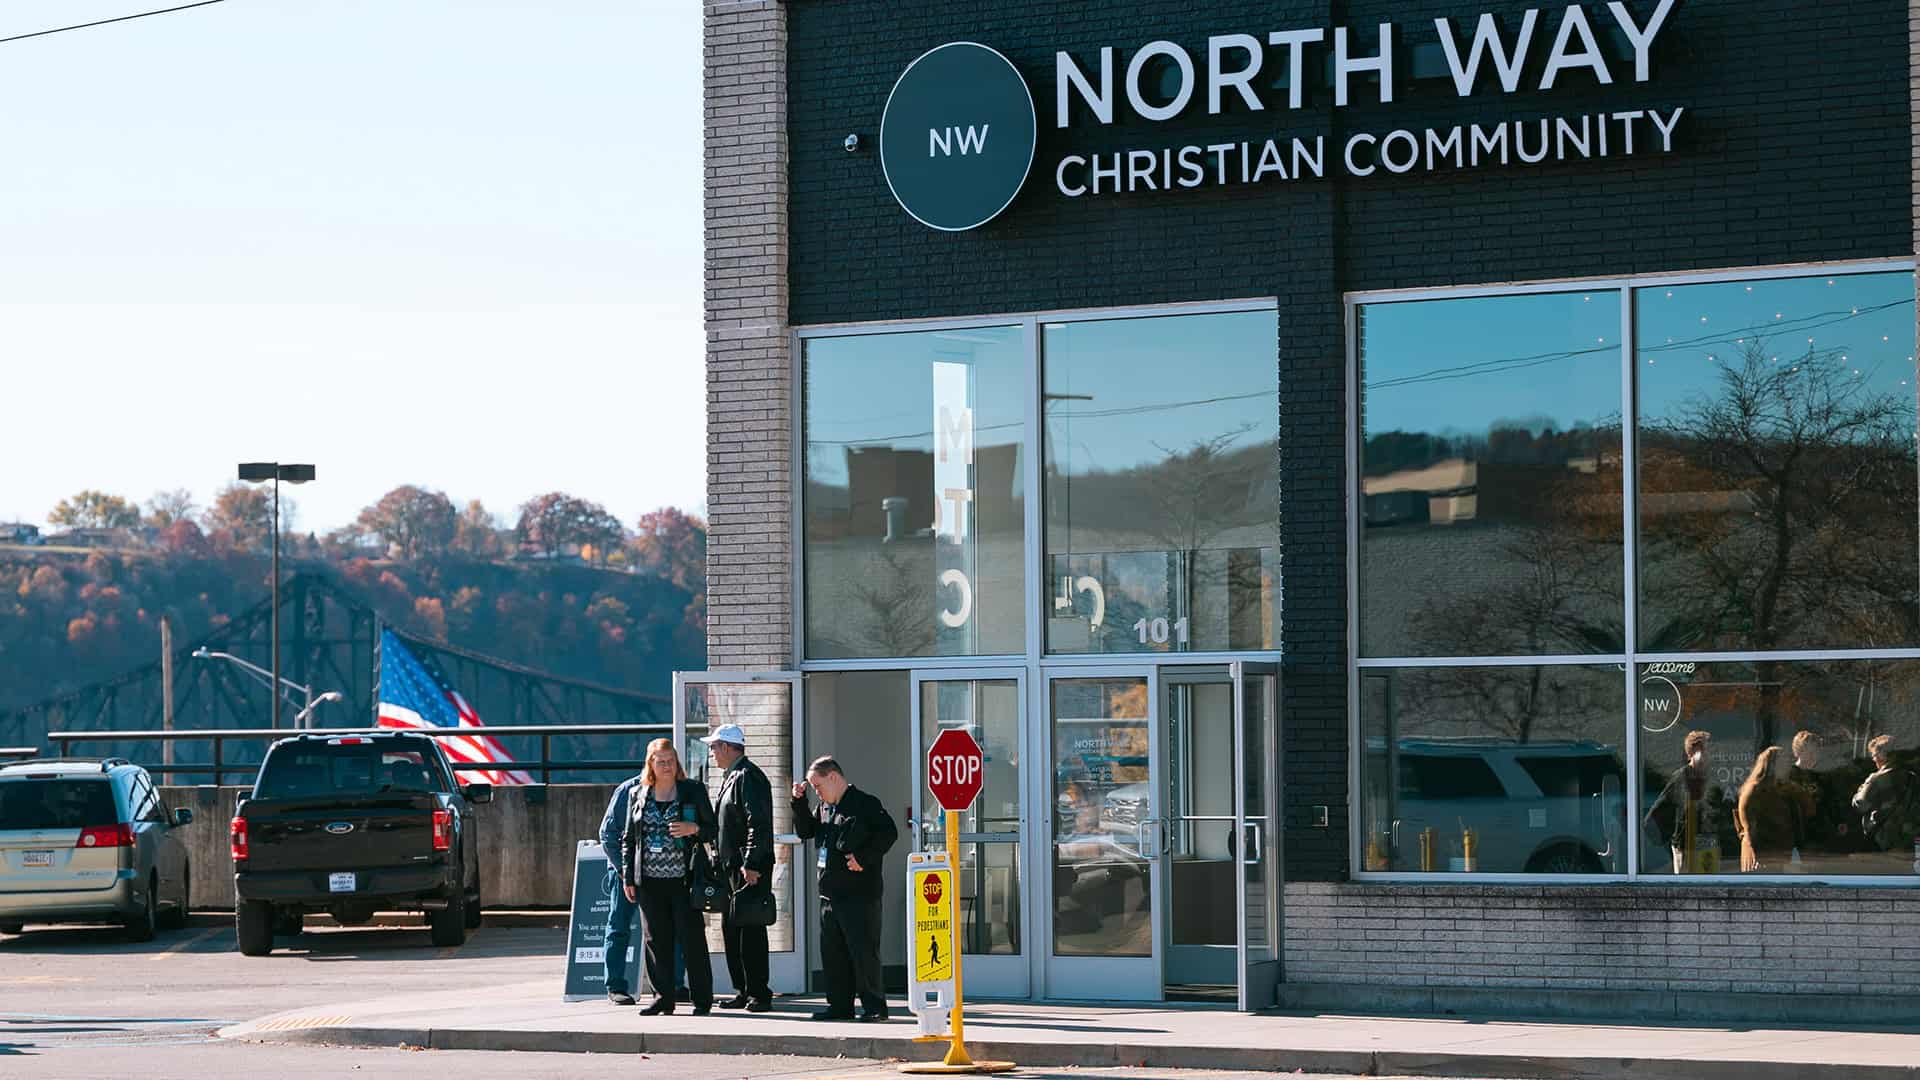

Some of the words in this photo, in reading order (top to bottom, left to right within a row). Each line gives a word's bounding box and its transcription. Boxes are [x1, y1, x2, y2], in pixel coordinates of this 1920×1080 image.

[1056, 23, 1393, 128] NORTH
[1434, 0, 1676, 98] WAY
[929, 124, 989, 159] NW
[1055, 134, 1325, 198] CHRISTIAN
[1344, 106, 1686, 178] COMMUNITY
[1133, 616, 1190, 644] 101
[1643, 698, 1671, 712] NW
[931, 755, 980, 785] STOP
[923, 882, 942, 896] STOP
[917, 918, 949, 932] PEDESTRIANS
[927, 906, 939, 917] FOR
